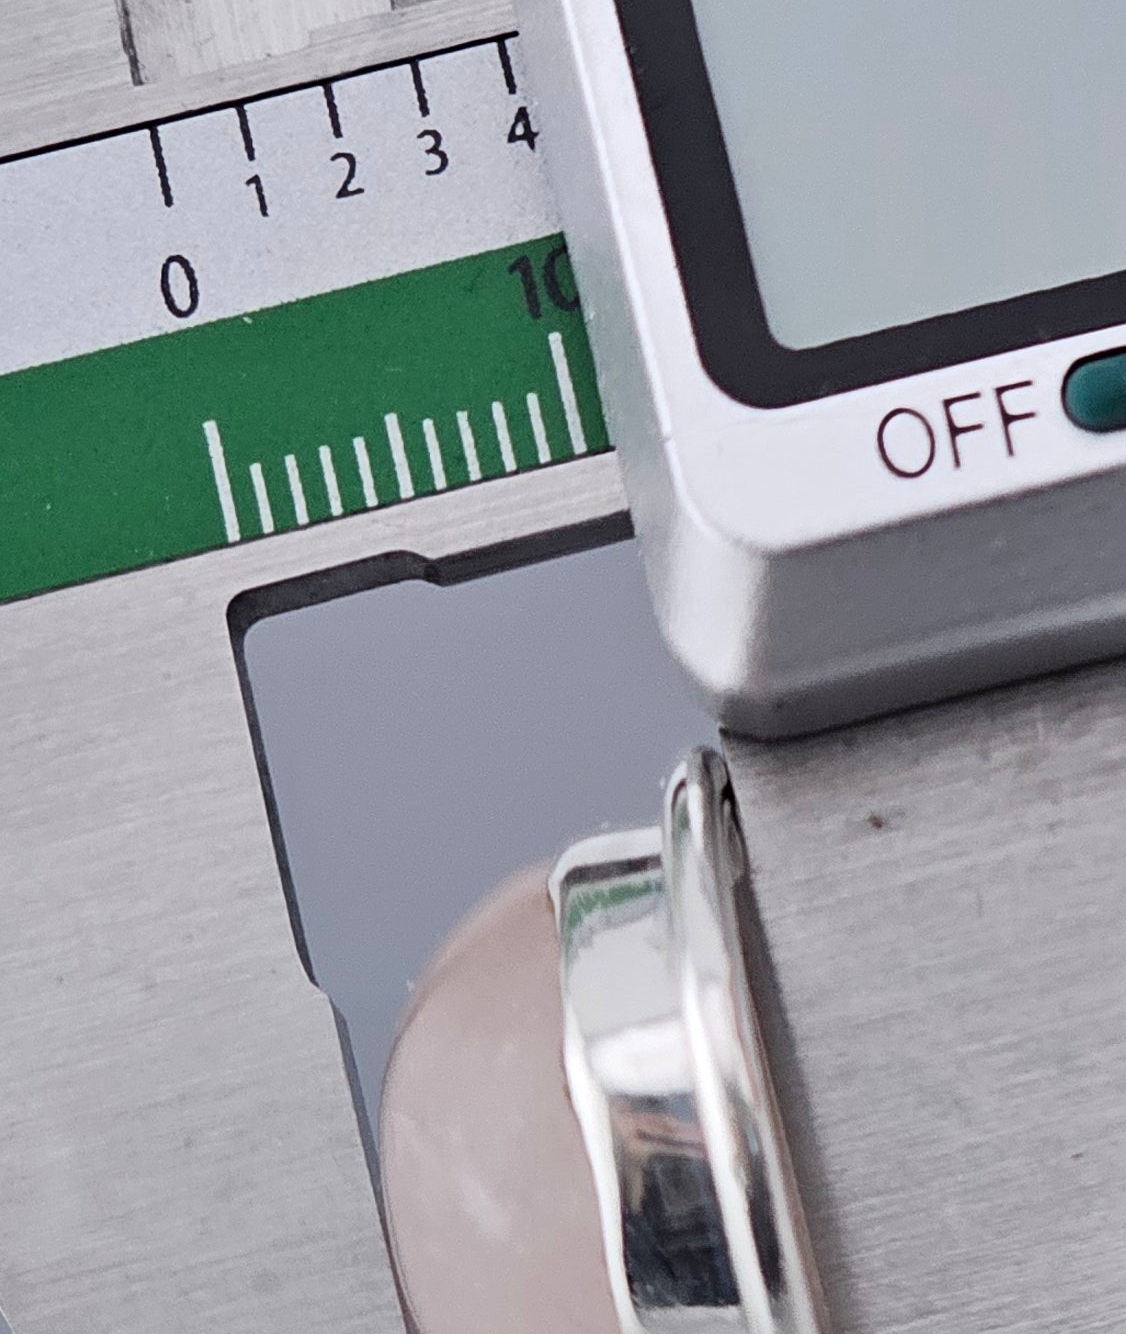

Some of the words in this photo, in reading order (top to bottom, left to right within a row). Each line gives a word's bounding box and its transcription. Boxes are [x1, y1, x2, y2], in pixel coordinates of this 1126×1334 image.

[245, 173, 269, 217] 1
[330, 152, 364, 199] 2
[417, 129, 449, 176] 3
[506, 106, 539, 152] 4
[160, 254, 200, 319] 0
[877, 380, 1036, 479] OFF
